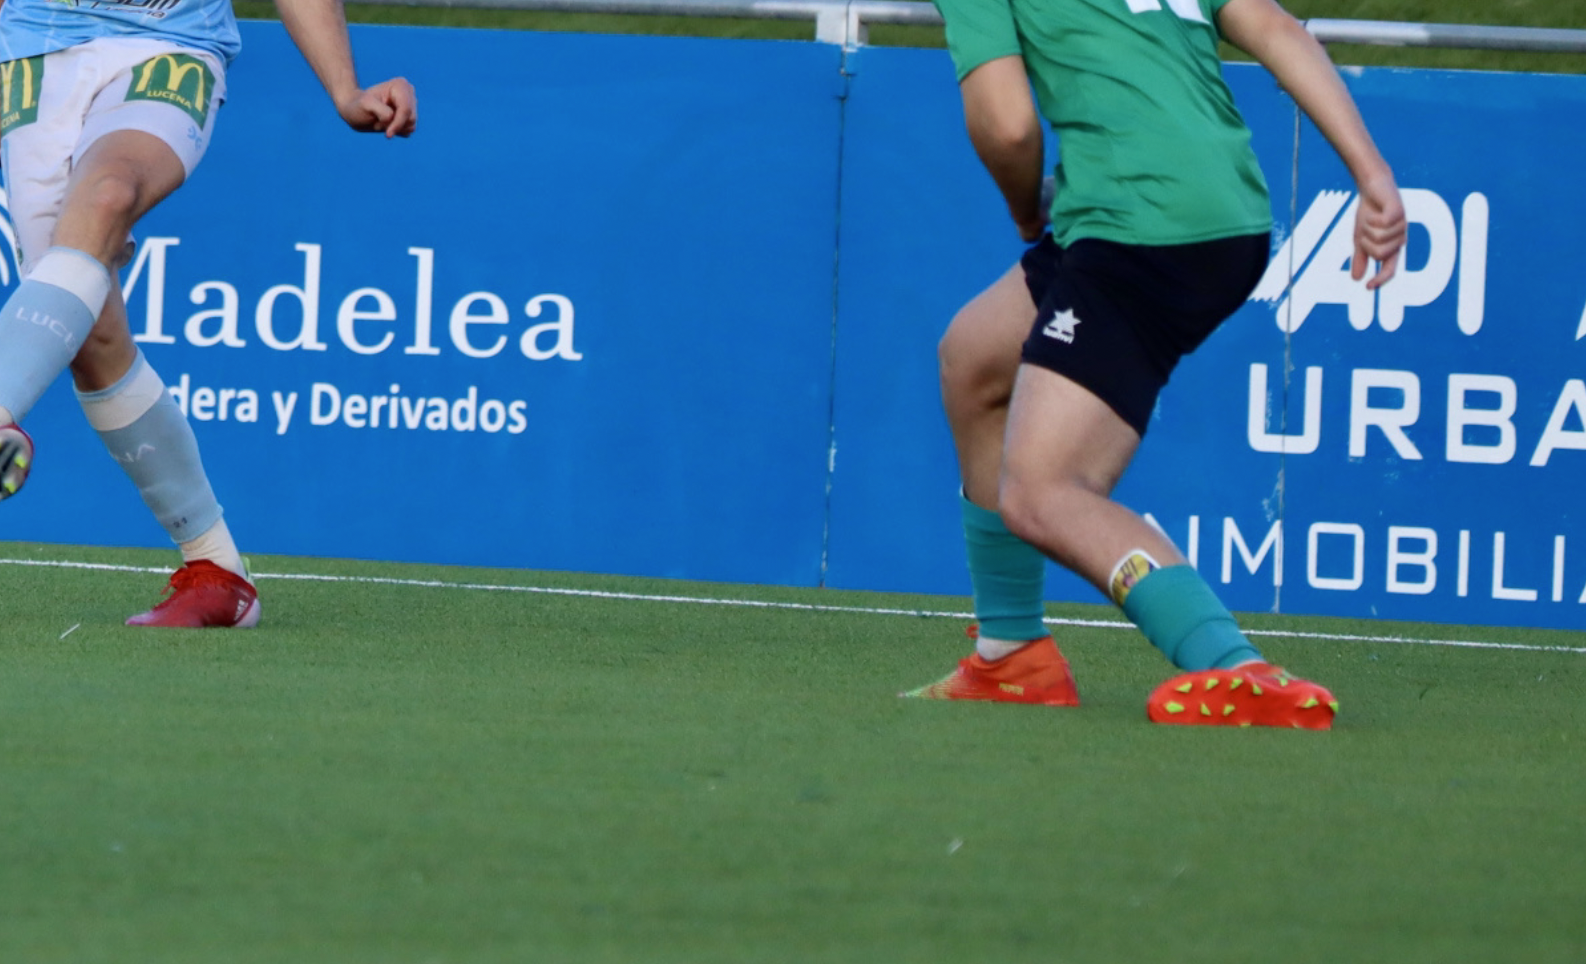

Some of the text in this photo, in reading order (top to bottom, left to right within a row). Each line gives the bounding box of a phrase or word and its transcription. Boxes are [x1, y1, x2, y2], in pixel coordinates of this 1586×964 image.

[147, 90, 192, 110] LUCENA
[124, 237, 583, 362] Madelea
[169, 374, 528, 434] dera y Derivados
